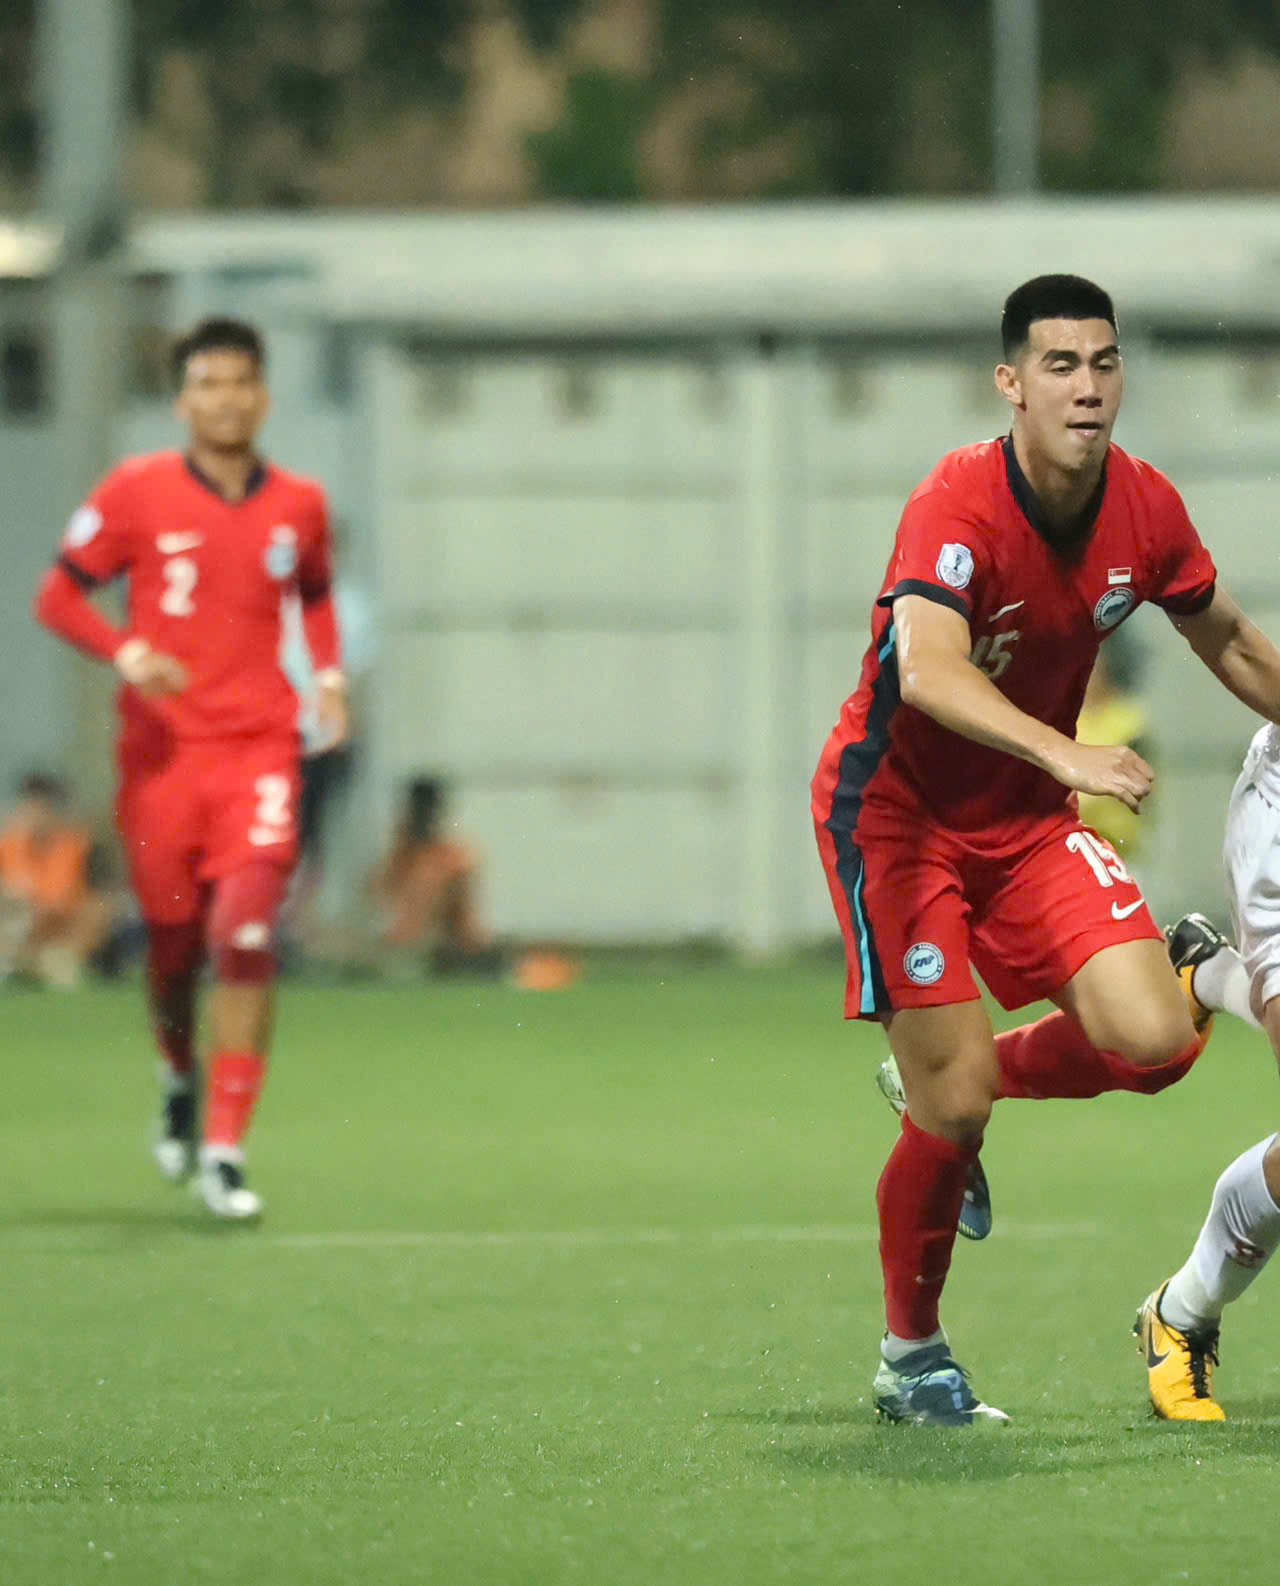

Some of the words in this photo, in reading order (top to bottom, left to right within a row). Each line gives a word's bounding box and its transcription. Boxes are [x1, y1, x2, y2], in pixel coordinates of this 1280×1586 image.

[160, 556, 198, 617] 2
[255, 774, 291, 826] 2
[1064, 830, 1133, 888] 15
